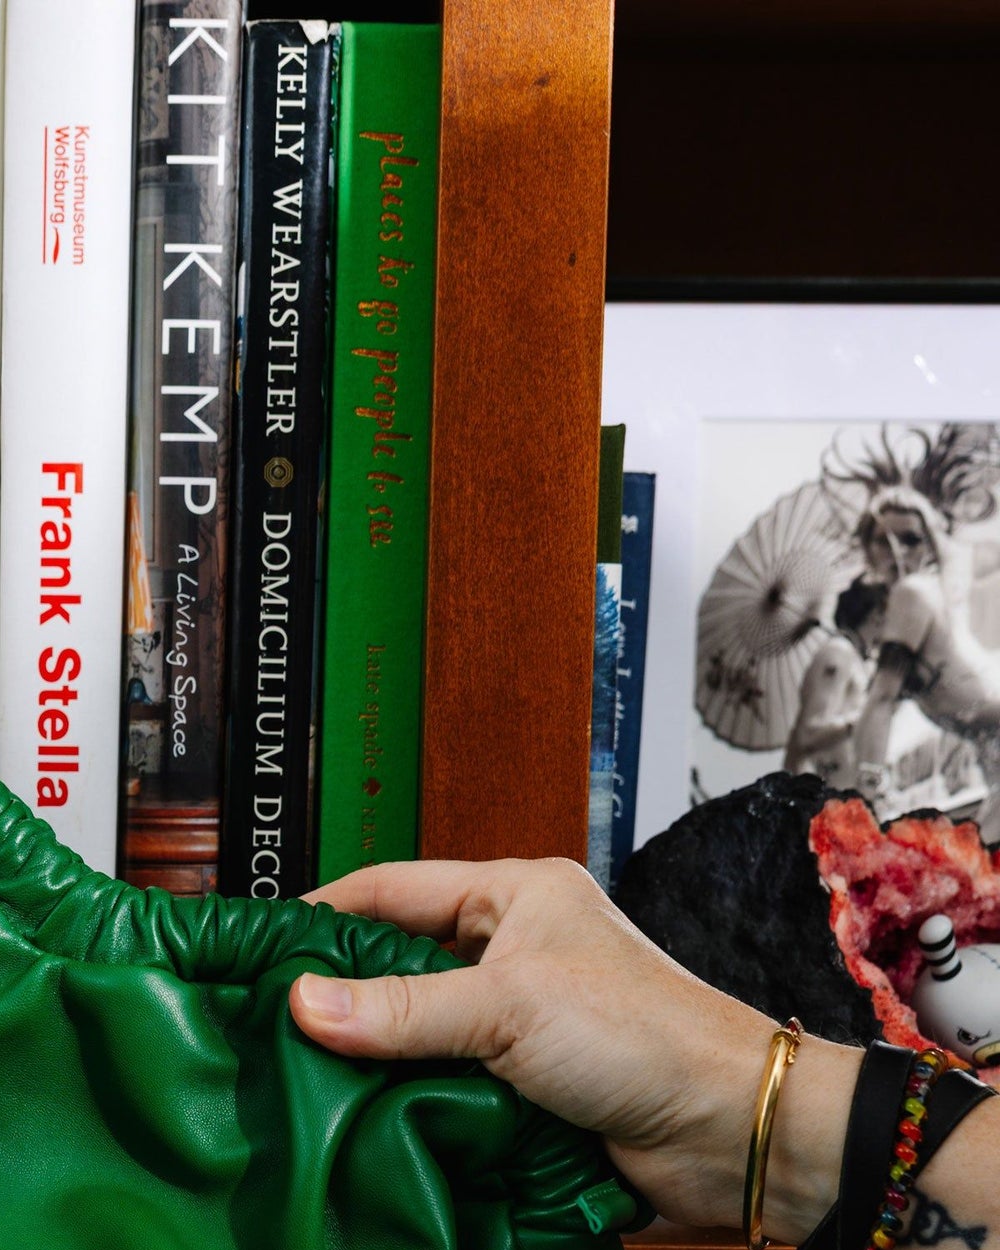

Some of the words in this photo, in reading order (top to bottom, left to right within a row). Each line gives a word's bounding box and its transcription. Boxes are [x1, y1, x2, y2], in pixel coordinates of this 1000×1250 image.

[165, 17, 229, 187] KIT
[273, 43, 308, 165] KELLY
[50, 125, 70, 225] Wolfsburg
[72, 125, 90, 266] Kunstmuseum
[265, 179, 303, 436] WEARSTLER
[357, 299, 400, 336] go
[158, 242, 224, 516] KEMP
[38, 461, 84, 626] Frank
[177, 543, 200, 564] A
[165, 571, 199, 668] Living
[253, 511, 293, 776] DOMICILIUM
[36, 646, 82, 808] Stella
[167, 675, 197, 759] Space
[358, 701, 385, 769] spade
[250, 795, 283, 899] DECO
